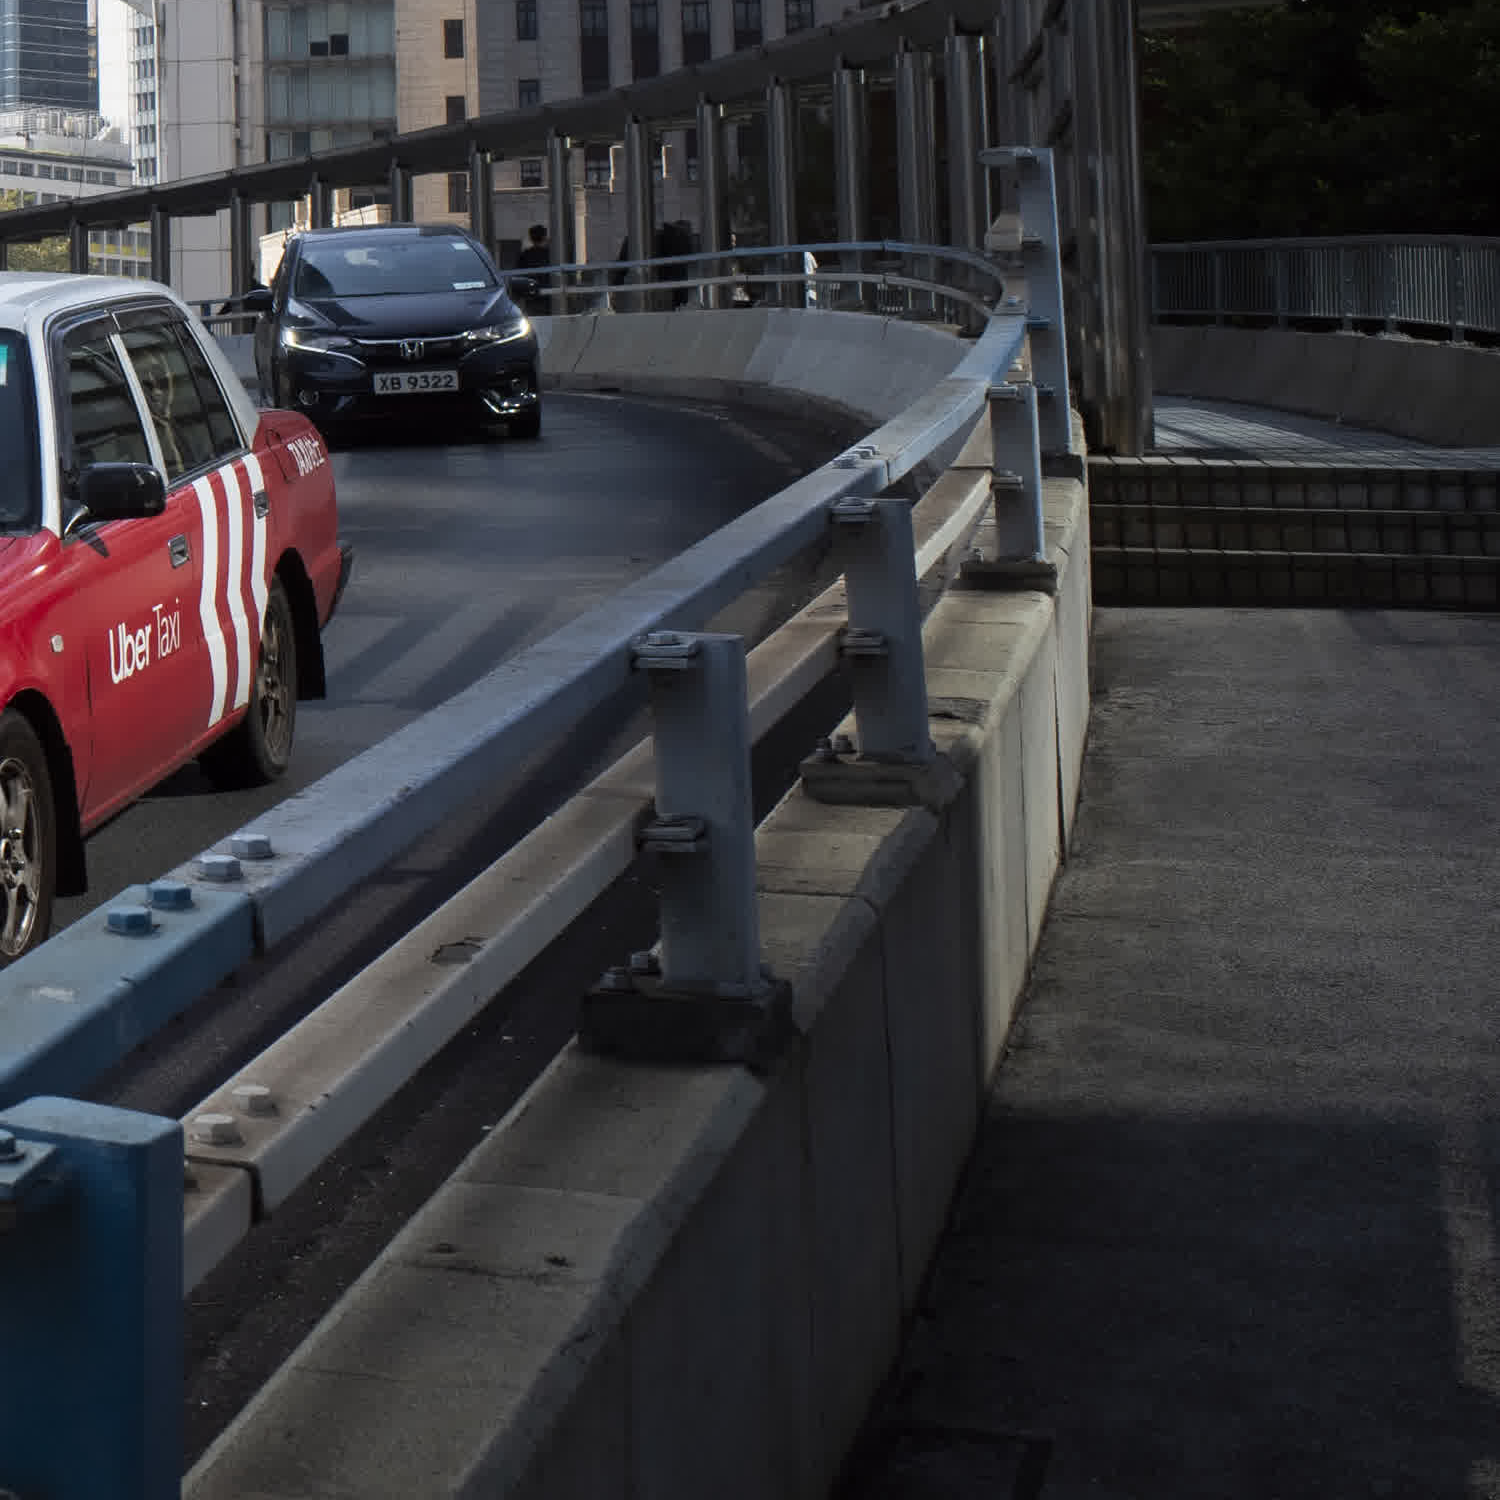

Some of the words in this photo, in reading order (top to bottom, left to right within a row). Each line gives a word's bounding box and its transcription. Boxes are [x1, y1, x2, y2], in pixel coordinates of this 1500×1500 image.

[380, 376, 401, 391] XB
[408, 374, 454, 389] 9322
[108, 621, 152, 685] Uber
[152, 596, 180, 660] Taxi
